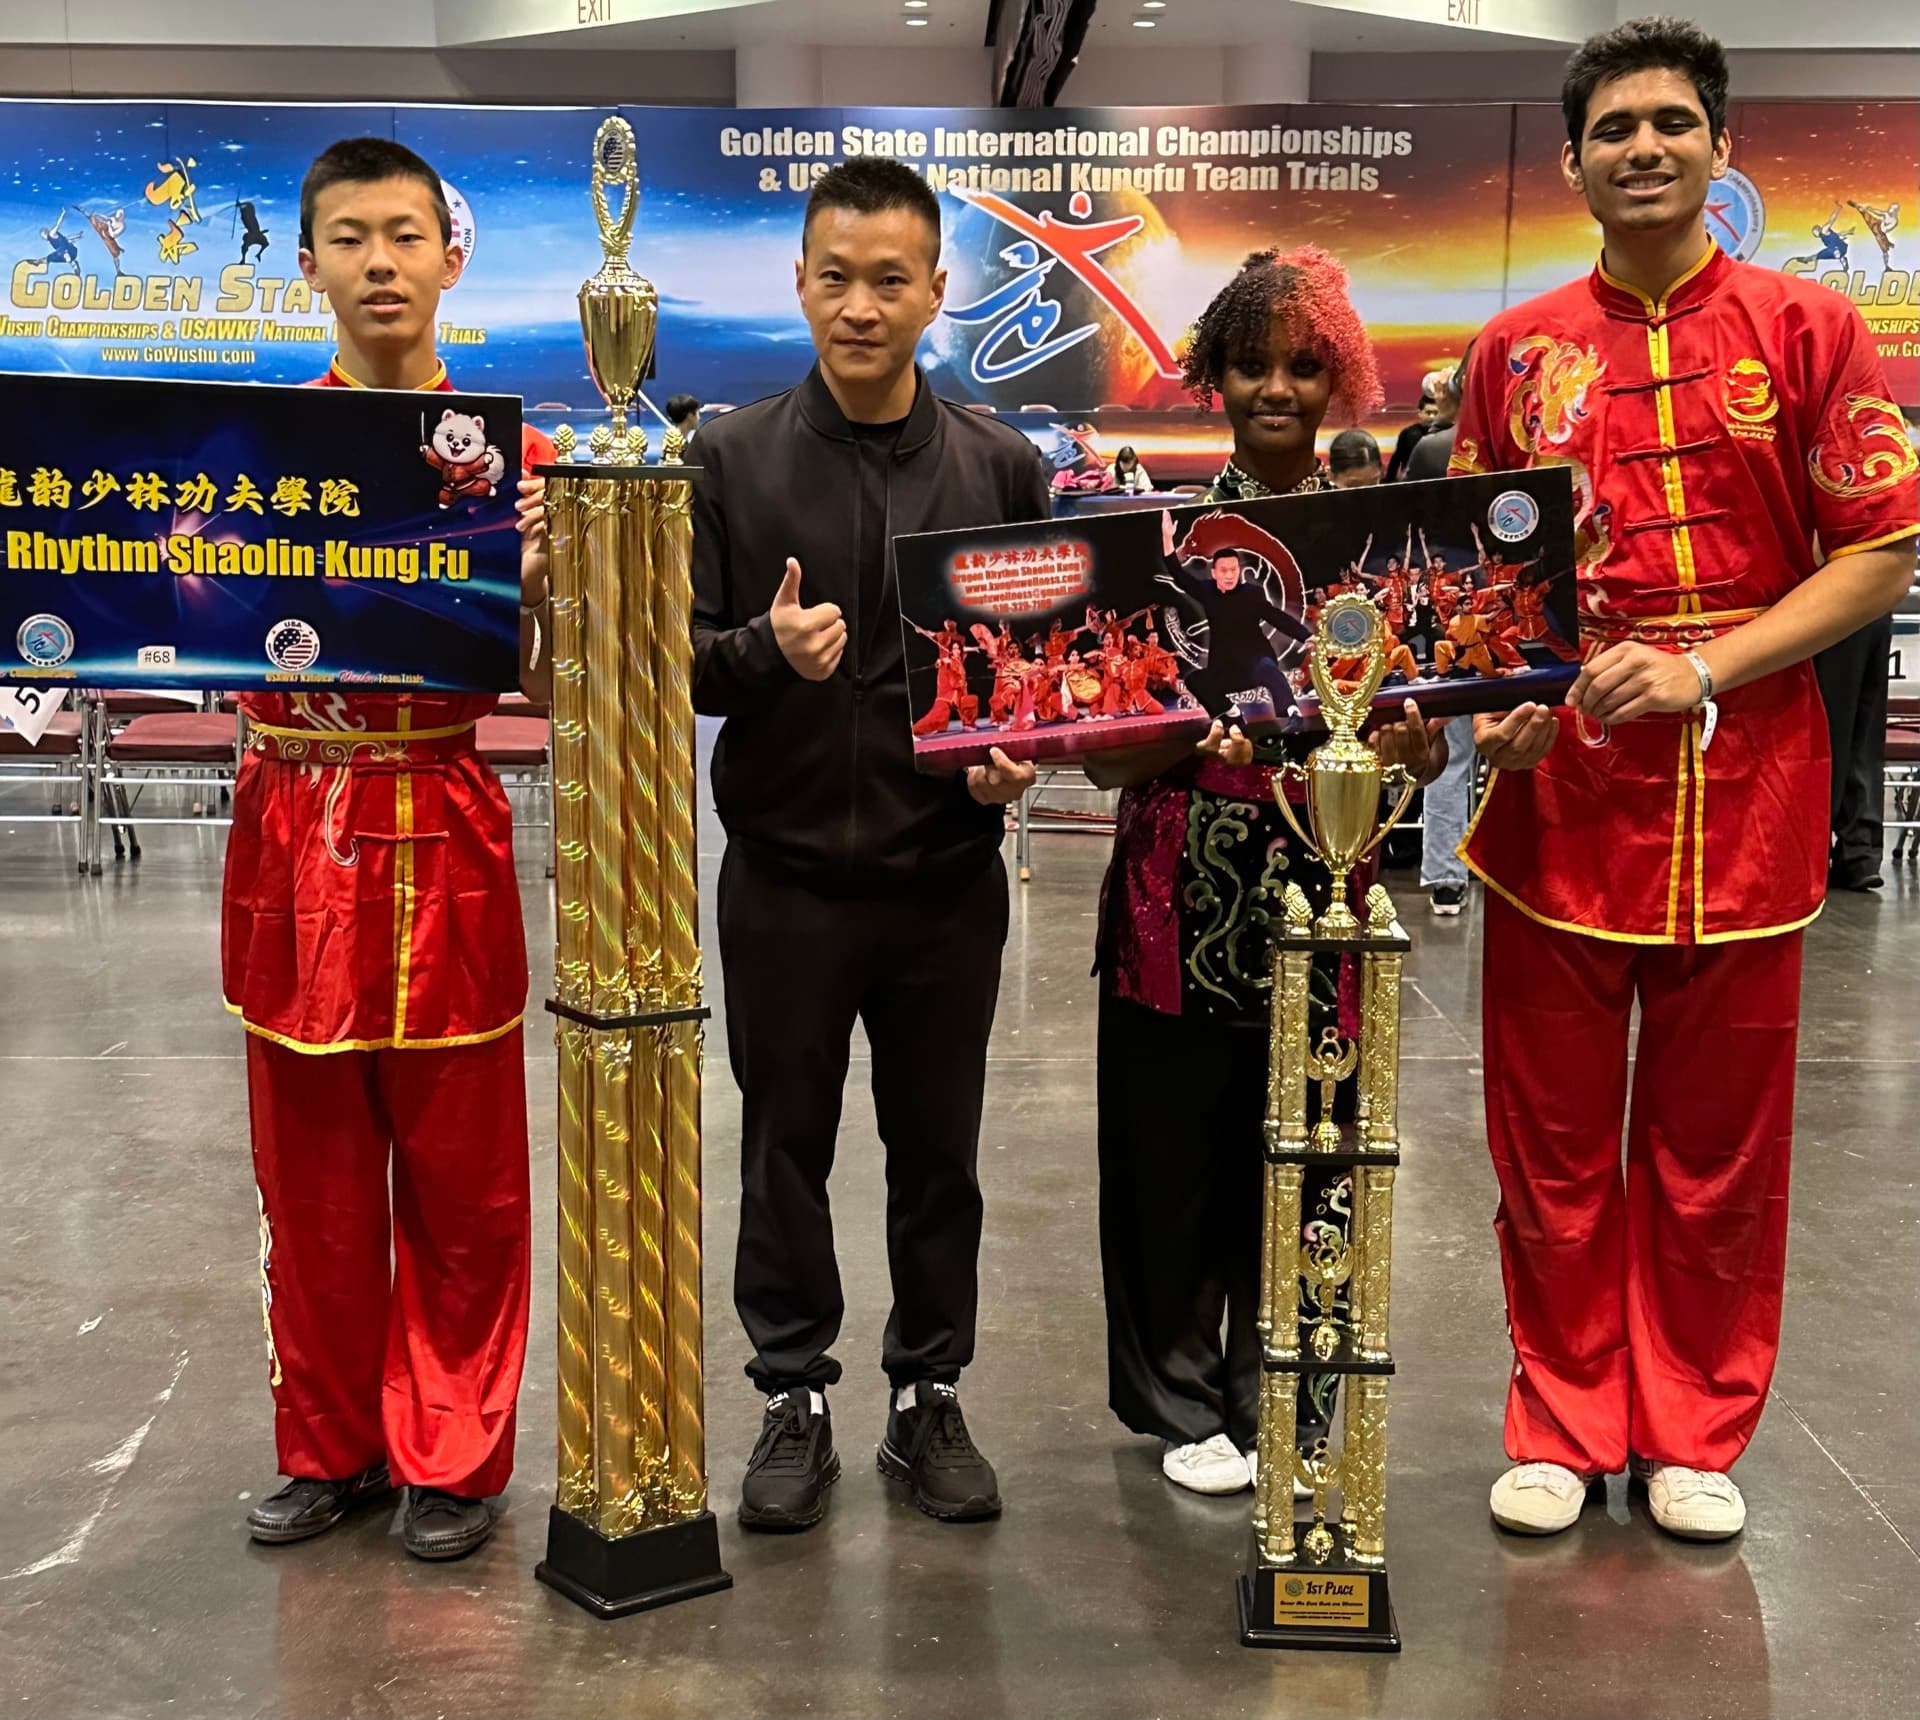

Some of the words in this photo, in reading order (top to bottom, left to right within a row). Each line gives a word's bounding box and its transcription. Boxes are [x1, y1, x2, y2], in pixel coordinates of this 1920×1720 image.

[720, 127, 834, 156] Golden
[842, 126, 928, 157] State
[935, 127, 1149, 157] International
[1156, 125, 1413, 158] Championships
[758, 167, 782, 192] &
[926, 163, 1062, 192] National
[1070, 163, 1186, 195] Kungfu
[1192, 161, 1279, 192] Team
[1287, 161, 1379, 192] Trials
[11, 259, 202, 312] GOLDEN
[47, 316, 158, 340] CHAMPIONSHIPS
[161, 320, 176, 340] &
[180, 318, 262, 342] USAWKF
[261, 320, 329, 343] NATIONAL
[439, 322, 487, 345] TRIALS
[101, 347, 256, 365] www.GoWushu.com
[7, 530, 158, 574] Rhythm
[167, 533, 316, 577] Shaolin
[324, 540, 420, 584] Kung
[429, 542, 470, 580] Fu
[144, 651, 171, 664] #68
